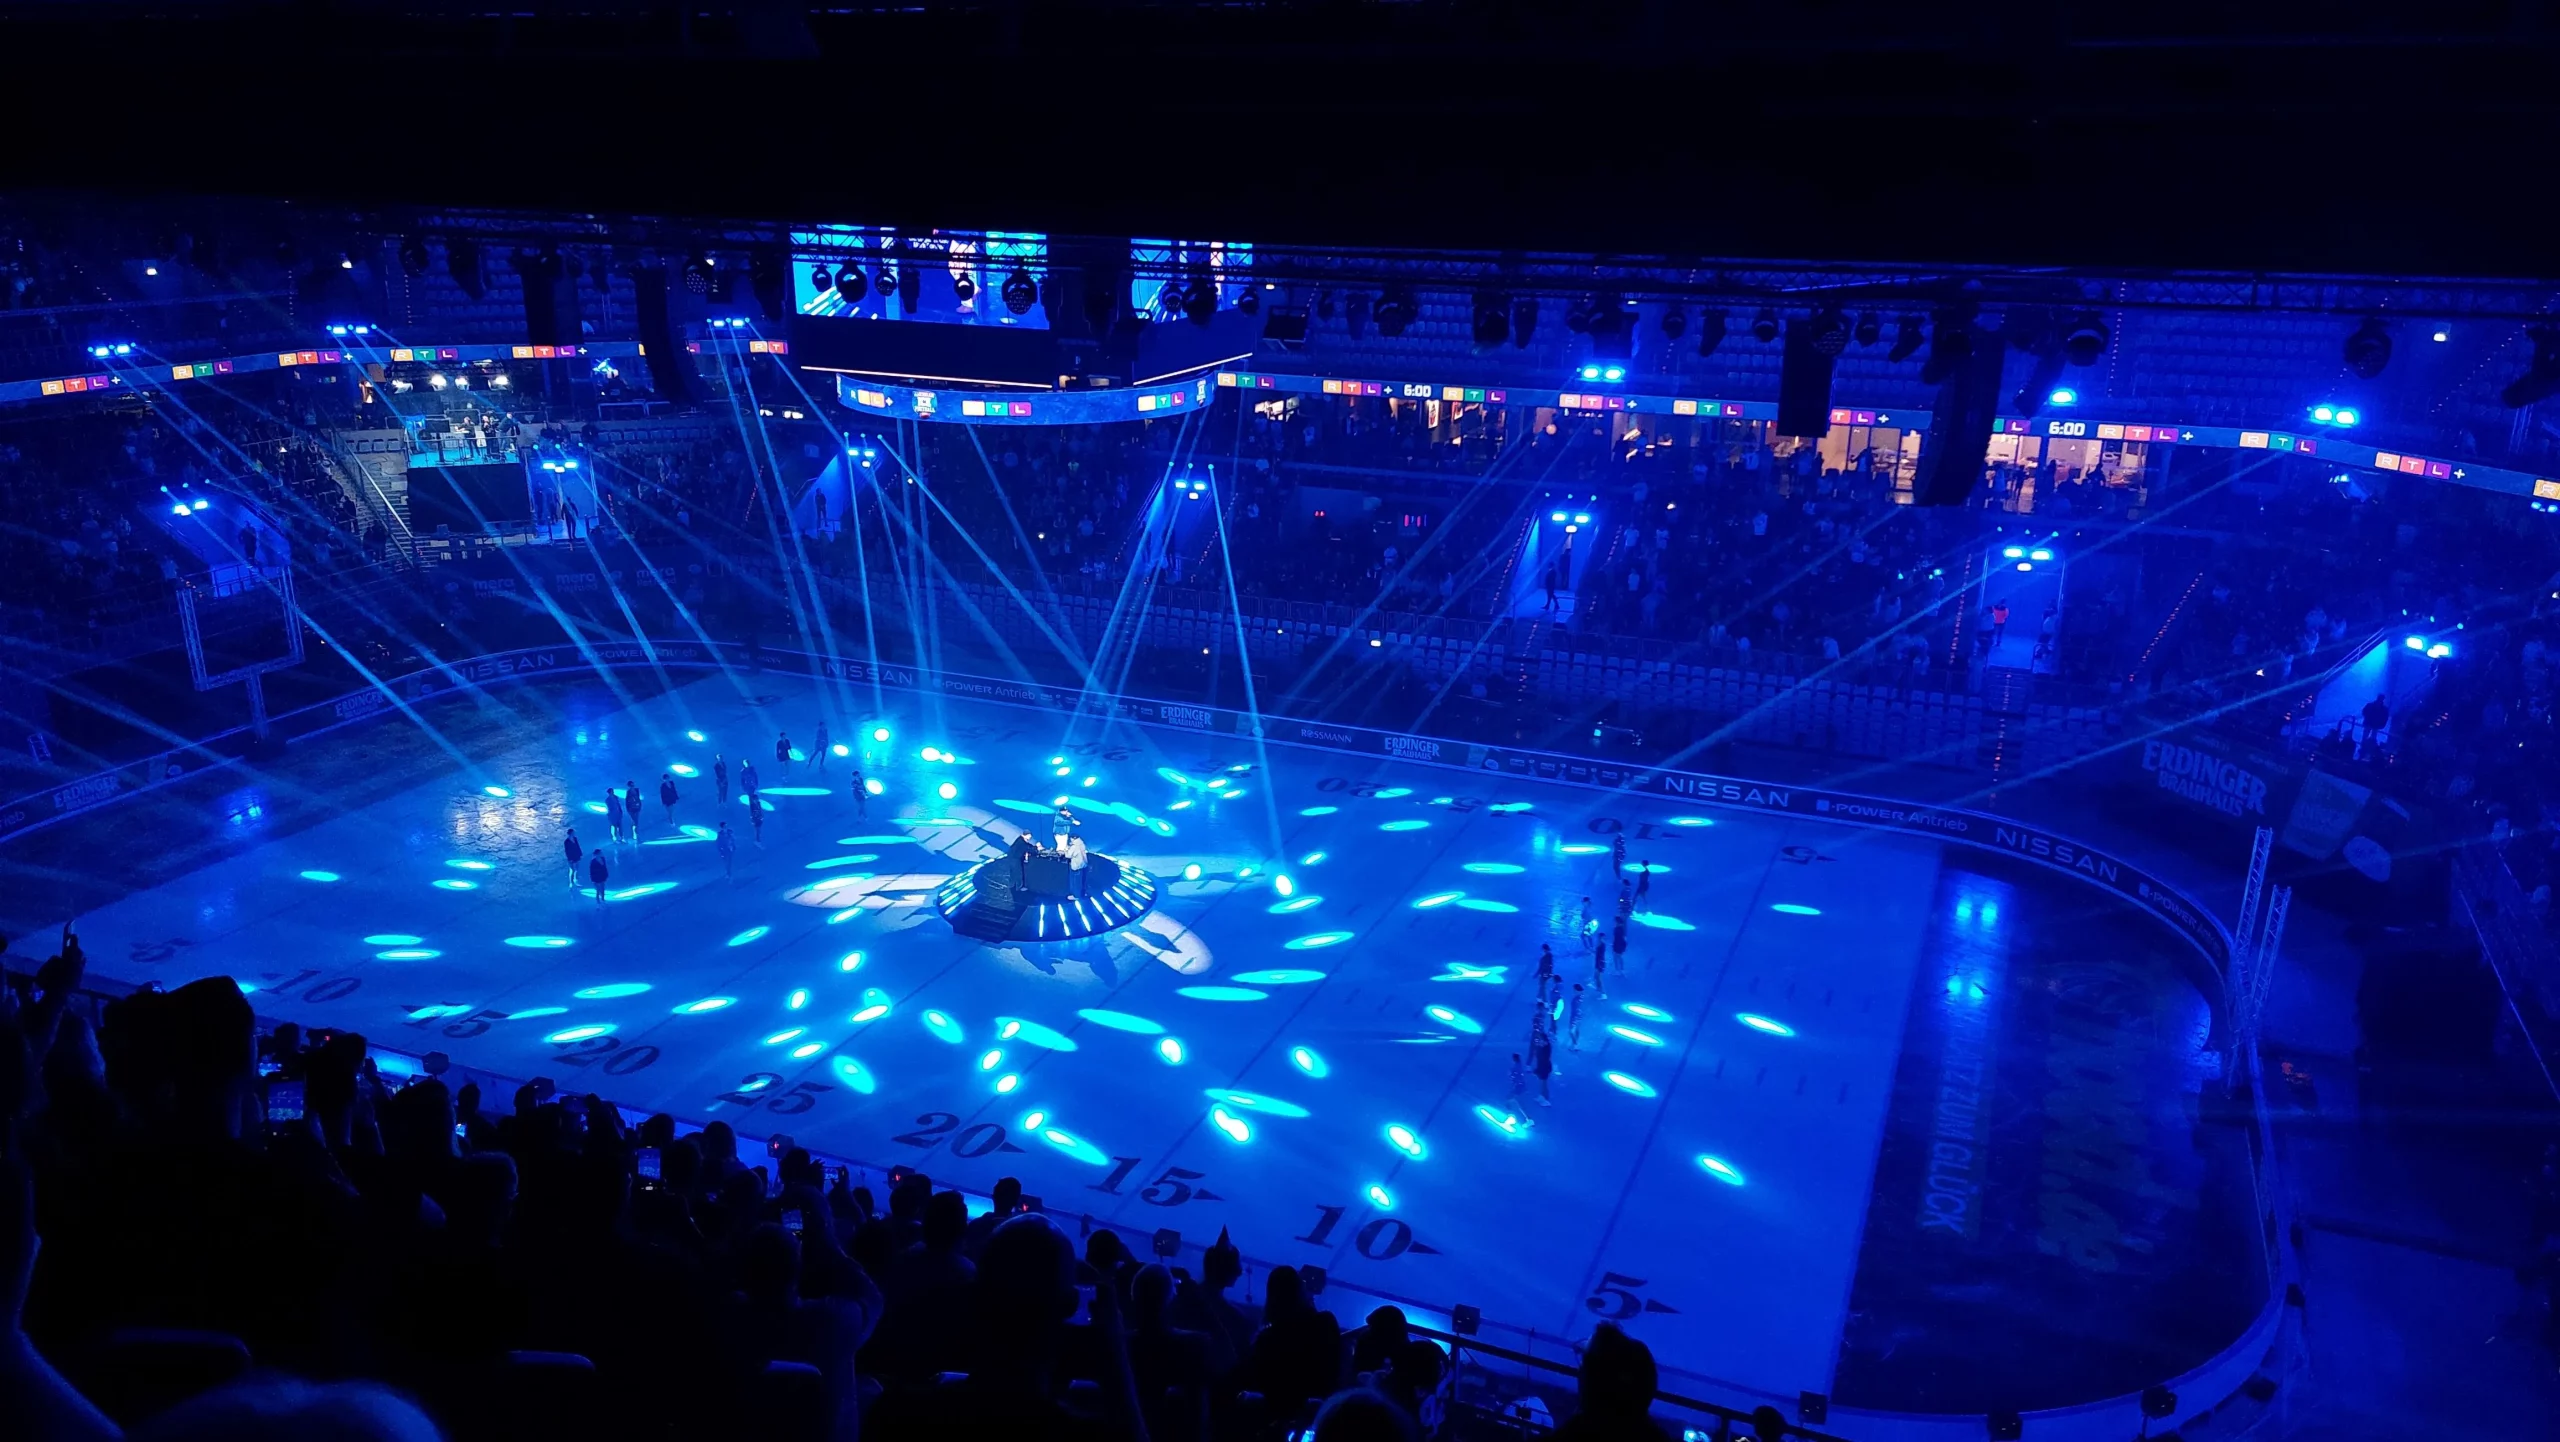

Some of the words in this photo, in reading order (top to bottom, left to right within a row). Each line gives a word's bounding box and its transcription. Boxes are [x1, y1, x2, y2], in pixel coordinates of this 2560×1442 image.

[393, 349, 455, 360] RTL
[175, 362, 231, 378] RTL
[1220, 375, 1272, 388] RTL
[1404, 384, 1432, 398] 6:00
[1139, 392, 1184, 412] TL
[1447, 389, 1502, 402] RTL
[963, 401, 1028, 416] TL
[1677, 403, 1739, 416] RTL
[2049, 421, 2085, 436] 6:00
[2245, 434, 2312, 451] RTL
[451, 653, 554, 684] NISSAN
[826, 661, 913, 686] NISSAN
[995, 686, 1036, 700] Antrieb
[1160, 705, 1212, 726] ERDINGER
[1300, 728, 1352, 743] ROSSMANN
[1384, 737, 1441, 758] ERDINGER
[2141, 739, 2267, 816] ERDINGER
[1664, 776, 1789, 808] NISSAN
[2157, 769, 2246, 818] BRAUHAUS
[1908, 811, 1968, 833] Antrieb
[1996, 827, 2118, 882] NISSAN
[260, 969, 362, 1004] 10
[551, 1035, 660, 1076] 20
[716, 1071, 833, 1115] 25
[892, 1111, 1006, 1158] 20
[1086, 1155, 1206, 1207] 15
[1920, 1141, 1980, 1236] GLÜCK
[1294, 1203, 1412, 1261] 10
[1585, 1271, 1648, 1320] 5
